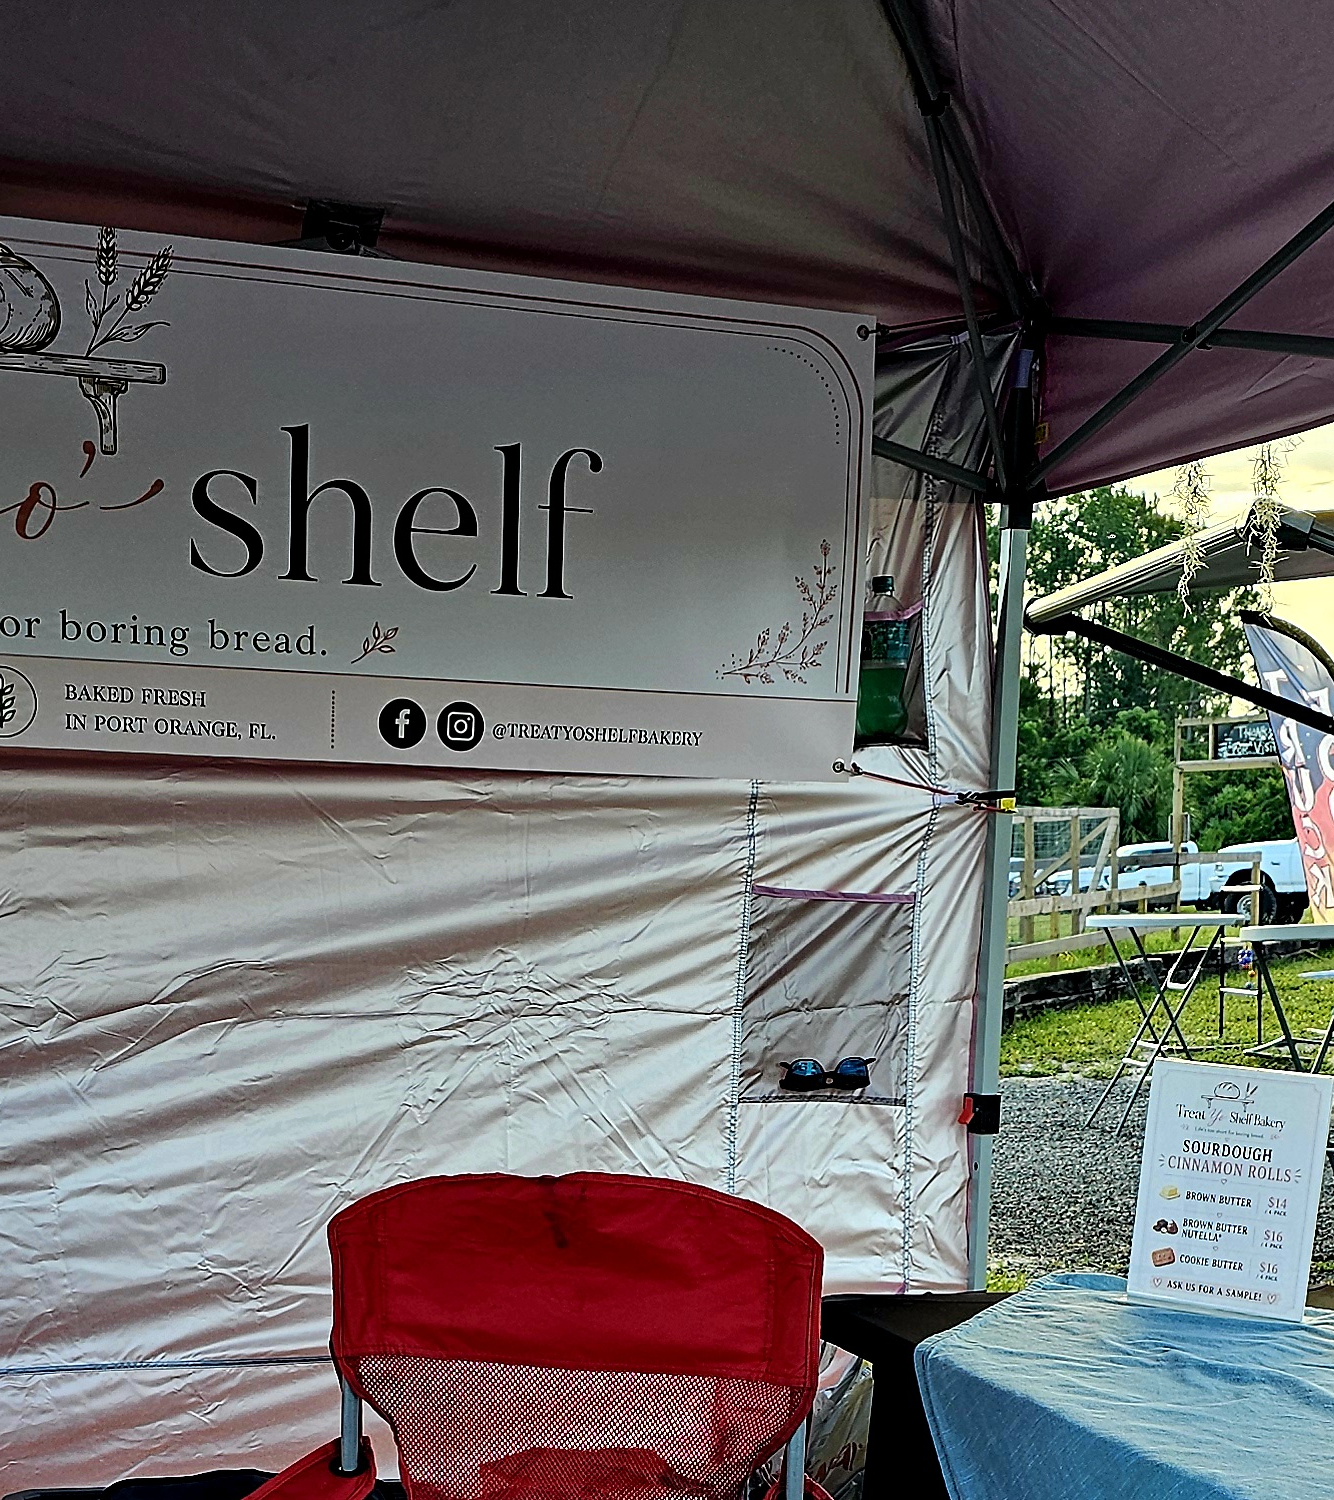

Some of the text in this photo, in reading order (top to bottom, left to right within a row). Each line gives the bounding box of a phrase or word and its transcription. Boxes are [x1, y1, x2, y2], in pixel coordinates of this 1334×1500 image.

[190, 422, 604, 600] shelf
[59, 609, 190, 657] boring
[208, 619, 328, 657] bread.
[65, 683, 207, 708] BAKED FRESH
[65, 713, 276, 741] IN PORT ORANGE, FL.
[492, 722, 703, 747] @TREATYOSHELFBAKERY
[1176, 1103, 1206, 1120] Treat
[1229, 1111, 1254, 1126] Shelf
[1254, 1114, 1286, 1132] Bakery
[1183, 1139, 1273, 1163] SOURDOUGH
[1168, 1155, 1292, 1183] CINNAMON ROLLS
[1185, 1190, 1252, 1208] BROWN BUTTER
[1268, 1196, 1287, 1210] $14
[1182, 1218, 1248, 1235] BROWN BUTTER
[1264, 1229, 1283, 1243] $16
[1179, 1254, 1244, 1272] COOKIE BUTTER
[1259, 1261, 1278, 1275] $16
[1167, 1280, 1262, 1301] ASK US FOR A SAMPLE!
